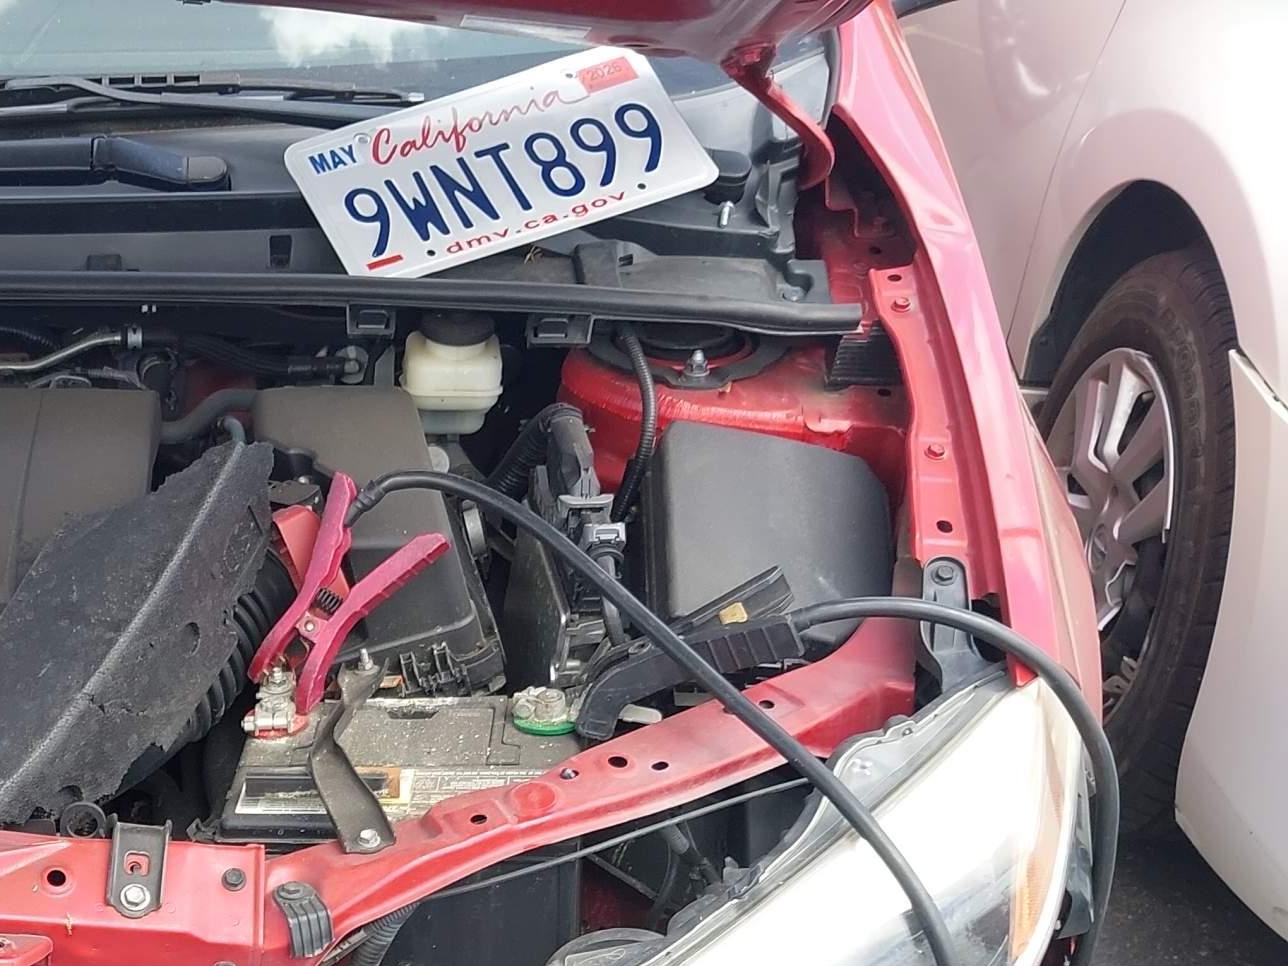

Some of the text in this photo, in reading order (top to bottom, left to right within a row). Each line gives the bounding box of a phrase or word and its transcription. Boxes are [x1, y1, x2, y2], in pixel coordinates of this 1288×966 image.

[308, 143, 359, 176] MAY
[371, 85, 592, 166] California
[343, 102, 663, 258] 9WNT899
[445, 190, 626, 255] dmv.ca.gov
